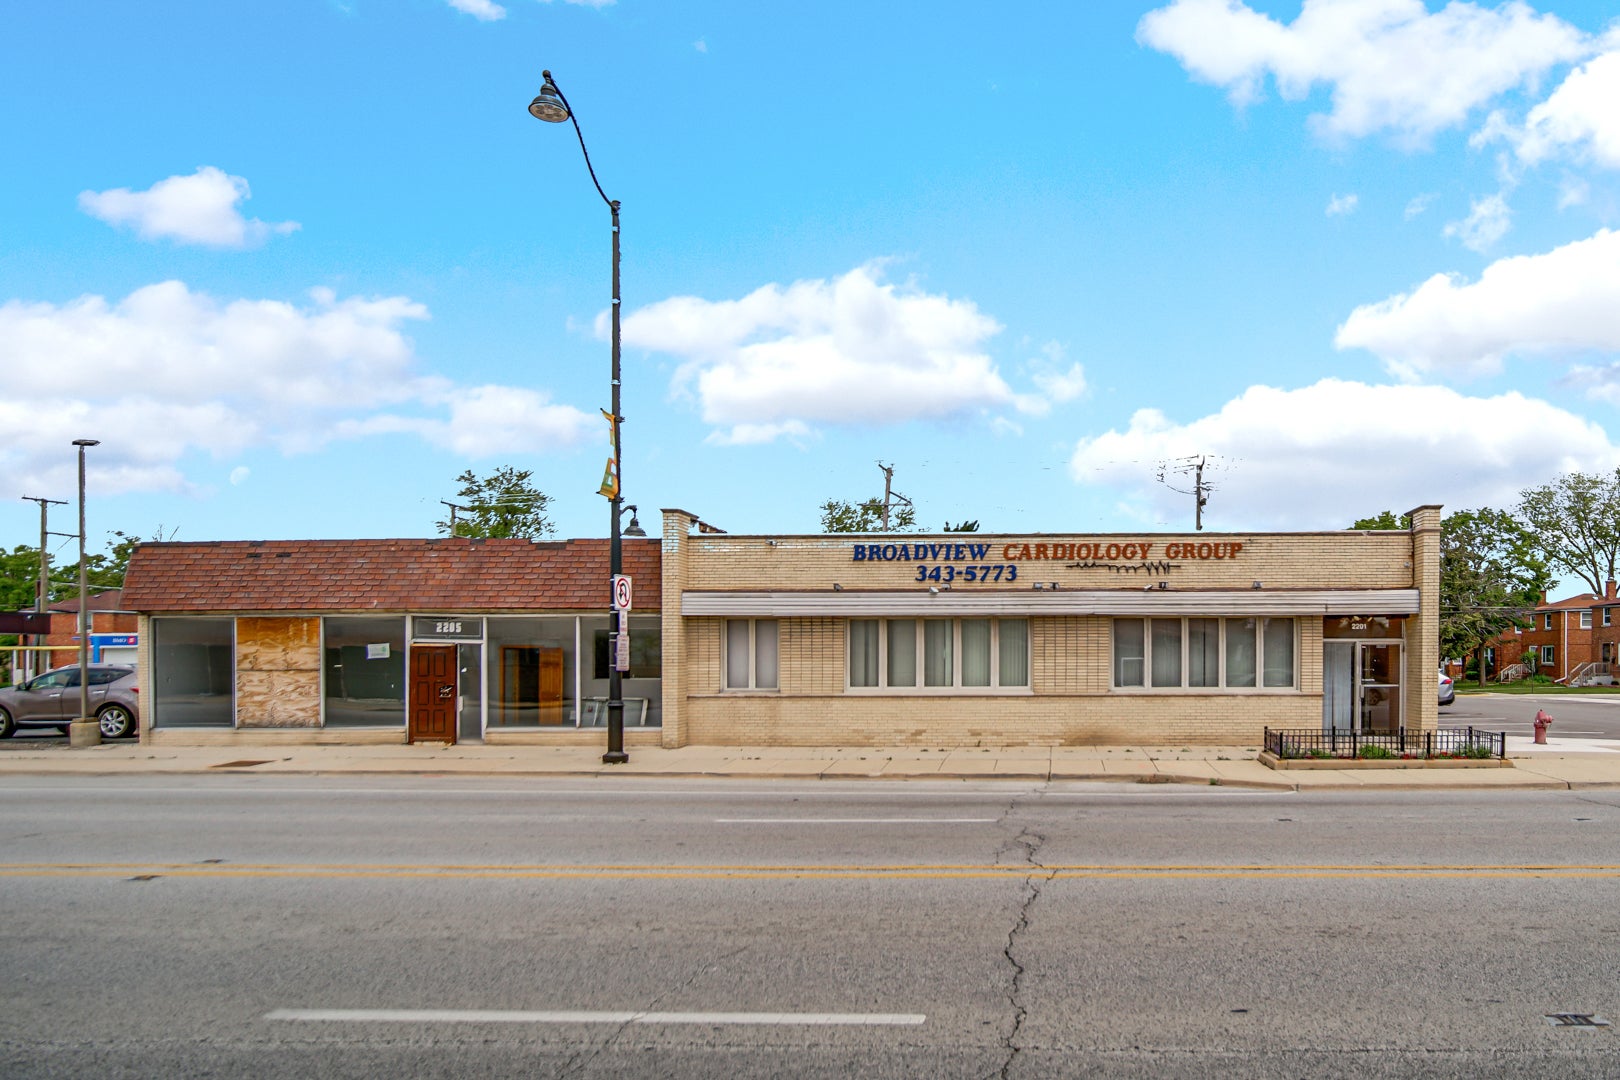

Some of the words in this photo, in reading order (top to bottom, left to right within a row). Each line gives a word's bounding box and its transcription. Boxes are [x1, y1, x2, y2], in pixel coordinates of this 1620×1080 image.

[853, 544, 991, 561] BROADVIEW
[1002, 543, 1153, 561] CARDIOLOGY
[1165, 542, 1243, 560] GROUP
[915, 565, 1017, 582] 343-5773
[436, 622, 462, 633] 2205
